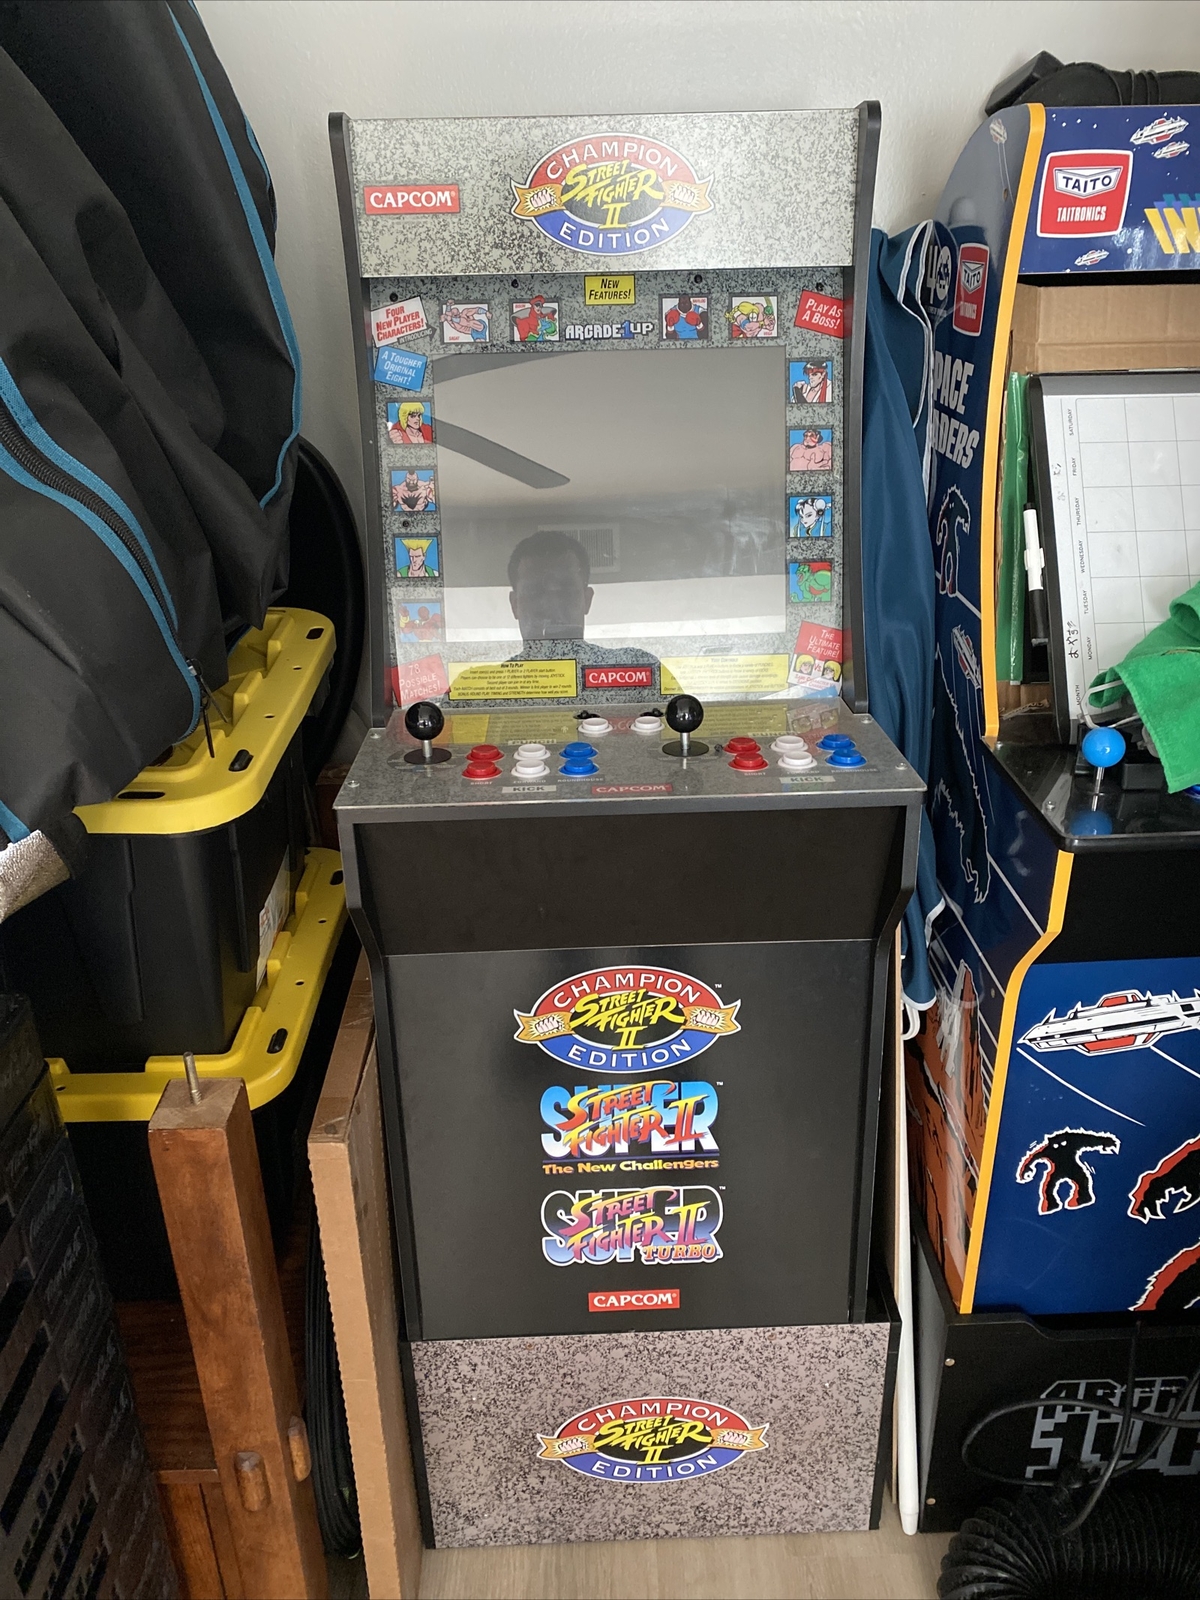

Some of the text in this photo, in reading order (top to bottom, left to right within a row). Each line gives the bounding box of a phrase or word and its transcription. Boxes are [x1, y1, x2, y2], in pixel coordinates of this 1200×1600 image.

[547, 141, 678, 180] CHAMPION
[561, 160, 630, 204] STREET
[574, 168, 665, 208] FIGHTER
[1062, 175, 1112, 193] TAITO
[370, 190, 452, 209] CAPCOM
[1056, 206, 1107, 223] TAITRONICS
[559, 218, 670, 248] EDITION
[600, 278, 620, 289] NEW
[588, 289, 632, 300] FEATURES!
[386, 306, 405, 318] FOUR
[805, 298, 843, 318] PLAY AS
[376, 311, 420, 332] NEW PLAYER
[376, 318, 424, 341] CHARACTERS!
[802, 312, 840, 330] A BOSS!
[382, 350, 422, 368] A TOUGHER
[384, 360, 416, 378] ORIGINAL
[386, 371, 412, 385] EIGHT!
[932, 350, 975, 415] PACE
[809, 635, 841, 650] ULTIMATE
[820, 630, 835, 640] THE
[806, 643, 840, 658] FEATURE!
[408, 663, 420, 676] 78
[588, 671, 647, 684] CAPCOM
[400, 672, 438, 688] POSSIBLE
[400, 680, 441, 700] MATCHES!
[596, 784, 666, 792] CAPCOM
[553, 973, 702, 1008] CHAMPION
[570, 988, 647, 1029] STREET
[586, 996, 686, 1032] FIGHTER
[567, 1038, 692, 1068] EDITION
[555, 1080, 678, 1131] STREET
[562, 1104, 672, 1158] FIGHTER
[542, 1159, 720, 1174] The New Challengers
[558, 1188, 678, 1236] STREET
[566, 1211, 674, 1260] FIGHTER
[644, 1244, 716, 1262] TURBO
[594, 1293, 673, 1308] CAPCOM
[577, 1402, 730, 1432] CHAMPION
[594, 1415, 674, 1448] STREET
[609, 1421, 714, 1451] FIGHTER
[592, 1454, 718, 1479] EDITION
